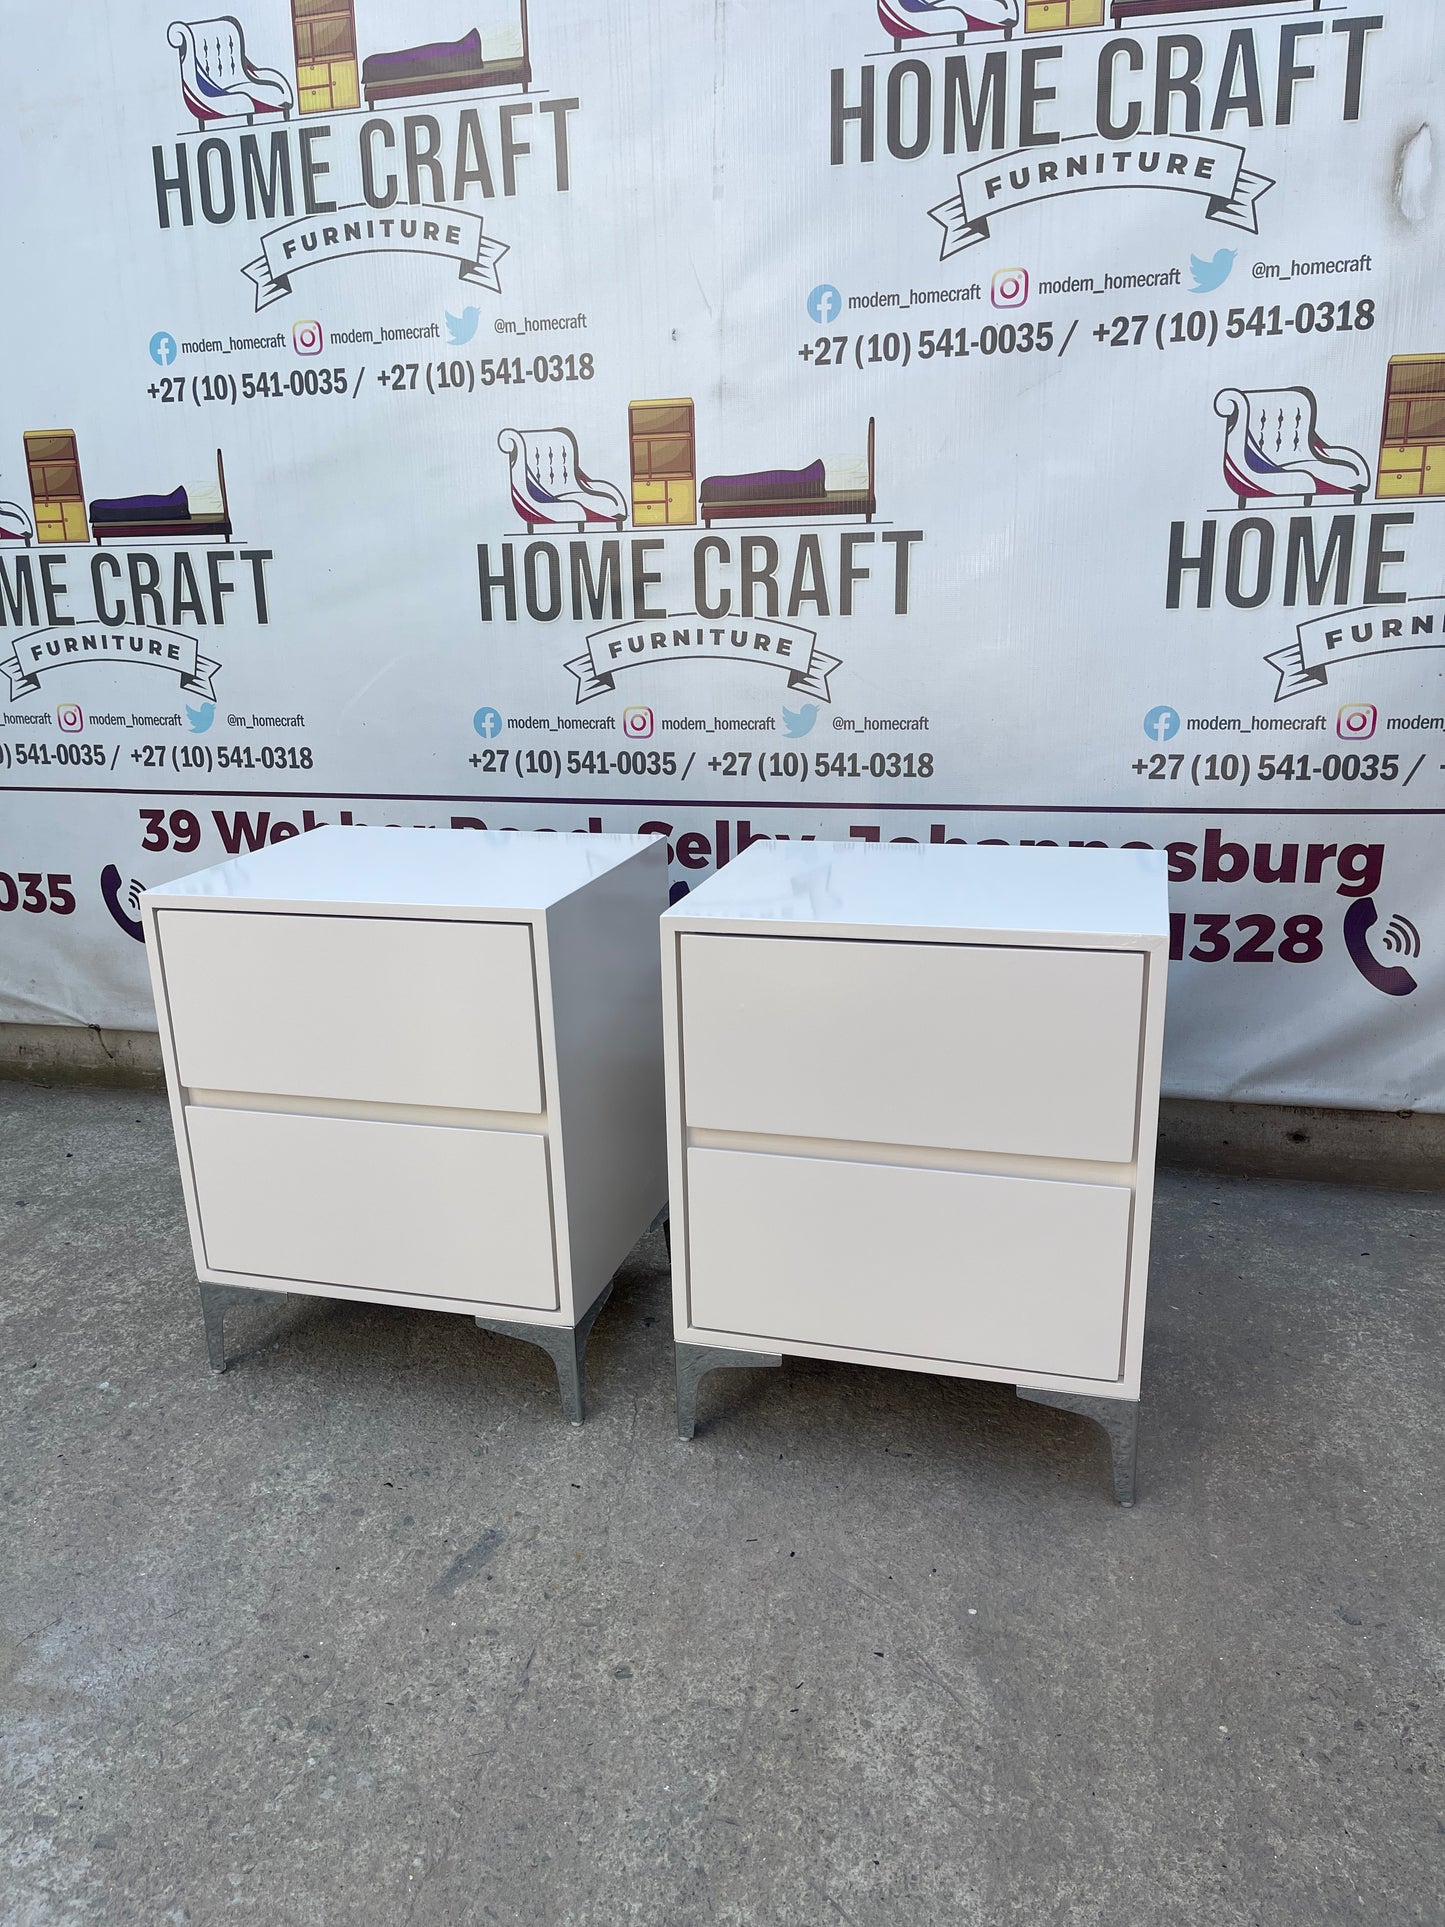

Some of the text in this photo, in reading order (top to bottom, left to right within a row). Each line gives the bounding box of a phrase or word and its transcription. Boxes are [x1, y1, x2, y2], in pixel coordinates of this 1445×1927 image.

[831, 15, 1383, 165] HOME CRAFT
[152, 97, 579, 229] HOME CRAFT
[985, 152, 1215, 200] FURNITURE
[283, 219, 460, 260] FURNITURE
[1252, 254, 1372, 280] @m_homecraft
[494, 313, 587, 335] @m_homecraft
[798, 336, 848, 366] +27
[855, 332, 911, 369] (10)
[918, 322, 1053, 359] 541-0035
[1093, 315, 1148, 347] +27
[1156, 310, 1218, 350] (10)
[1226, 299, 1375, 338] 541-0318
[147, 377, 185, 403] +27
[192, 374, 237, 407] (10)
[242, 368, 347, 398] 541-0035
[377, 364, 419, 390] +27
[426, 360, 474, 394] (10)
[481, 353, 594, 386] 541-0318
[477, 526, 923, 621] HOME CRAFT
[1166, 512, 1414, 609] HOME
[91, 550, 273, 627] CRAFT
[31, 635, 180, 661] FURNITURE
[608, 629, 792, 659] FURNITURE
[227, 714, 305, 729] @m_homecraft
[833, 716, 929, 733] @m_homecraft
[15, 743, 106, 765] 541-0035
[131, 745, 166, 767] +27
[172, 746, 212, 772] (10)
[217, 746, 313, 769] 541-0318
[469, 749, 509, 772] +27
[516, 750, 561, 779] (10)
[567, 751, 676, 775] 541-0035
[708, 752, 752, 776] +27
[759, 752, 808, 782] (10)
[815, 753, 933, 778] 541-0318
[1132, 754, 1184, 780] +27
[1192, 754, 1250, 786] (10)
[1258, 754, 1399, 781] 541-0035
[139, 809, 201, 853] 39
